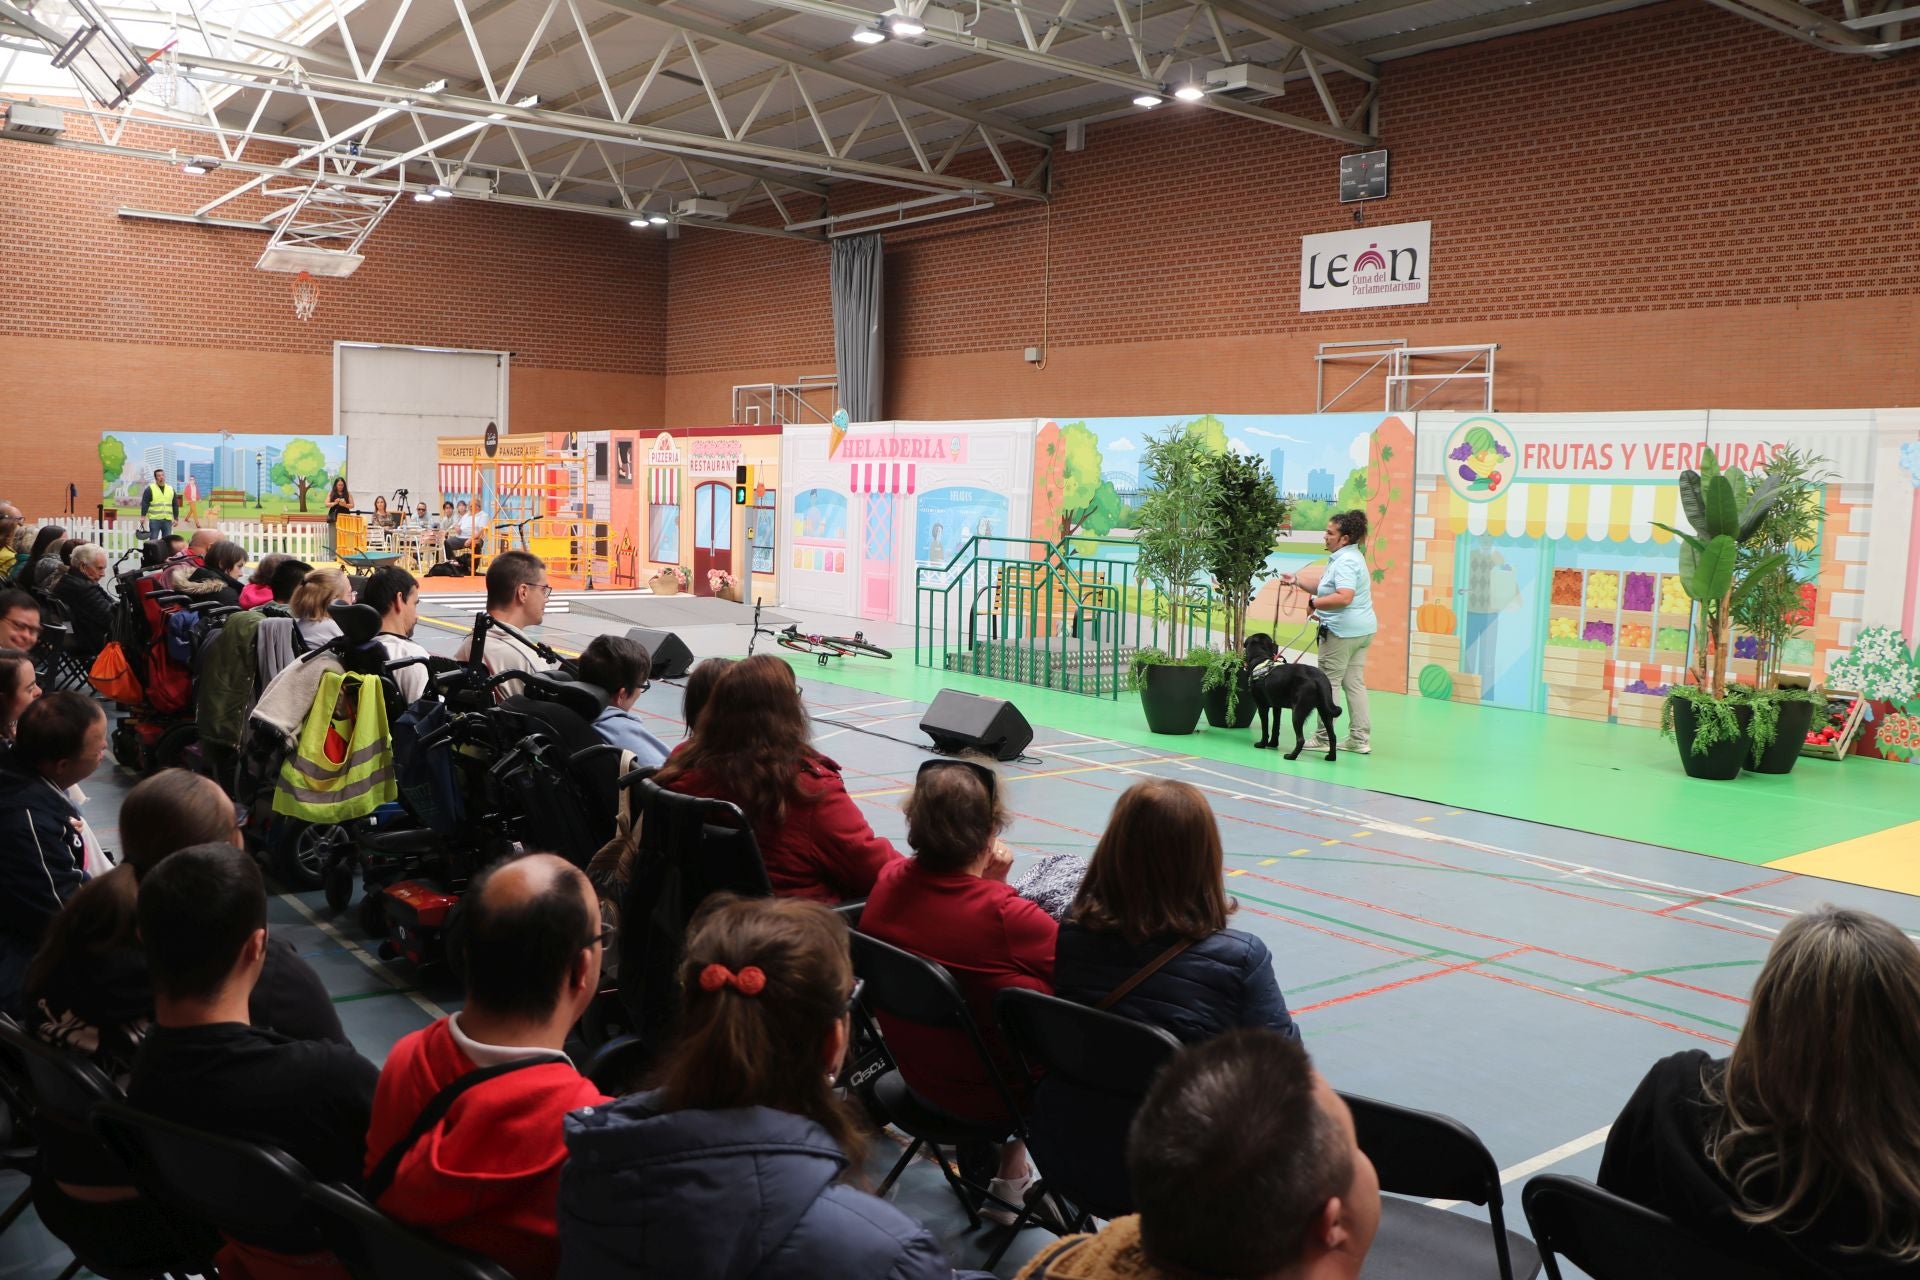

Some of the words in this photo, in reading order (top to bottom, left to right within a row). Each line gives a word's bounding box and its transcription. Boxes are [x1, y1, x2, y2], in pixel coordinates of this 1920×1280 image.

[1352, 274, 1373, 285] Cuna
[1374, 271, 1386, 282] del
[1352, 281, 1421, 295] Parlamentarismo
[499, 447, 529, 456] PANADERA
[1523, 442, 1613, 470] FRUTAS
[1620, 442, 1638, 470] Y
